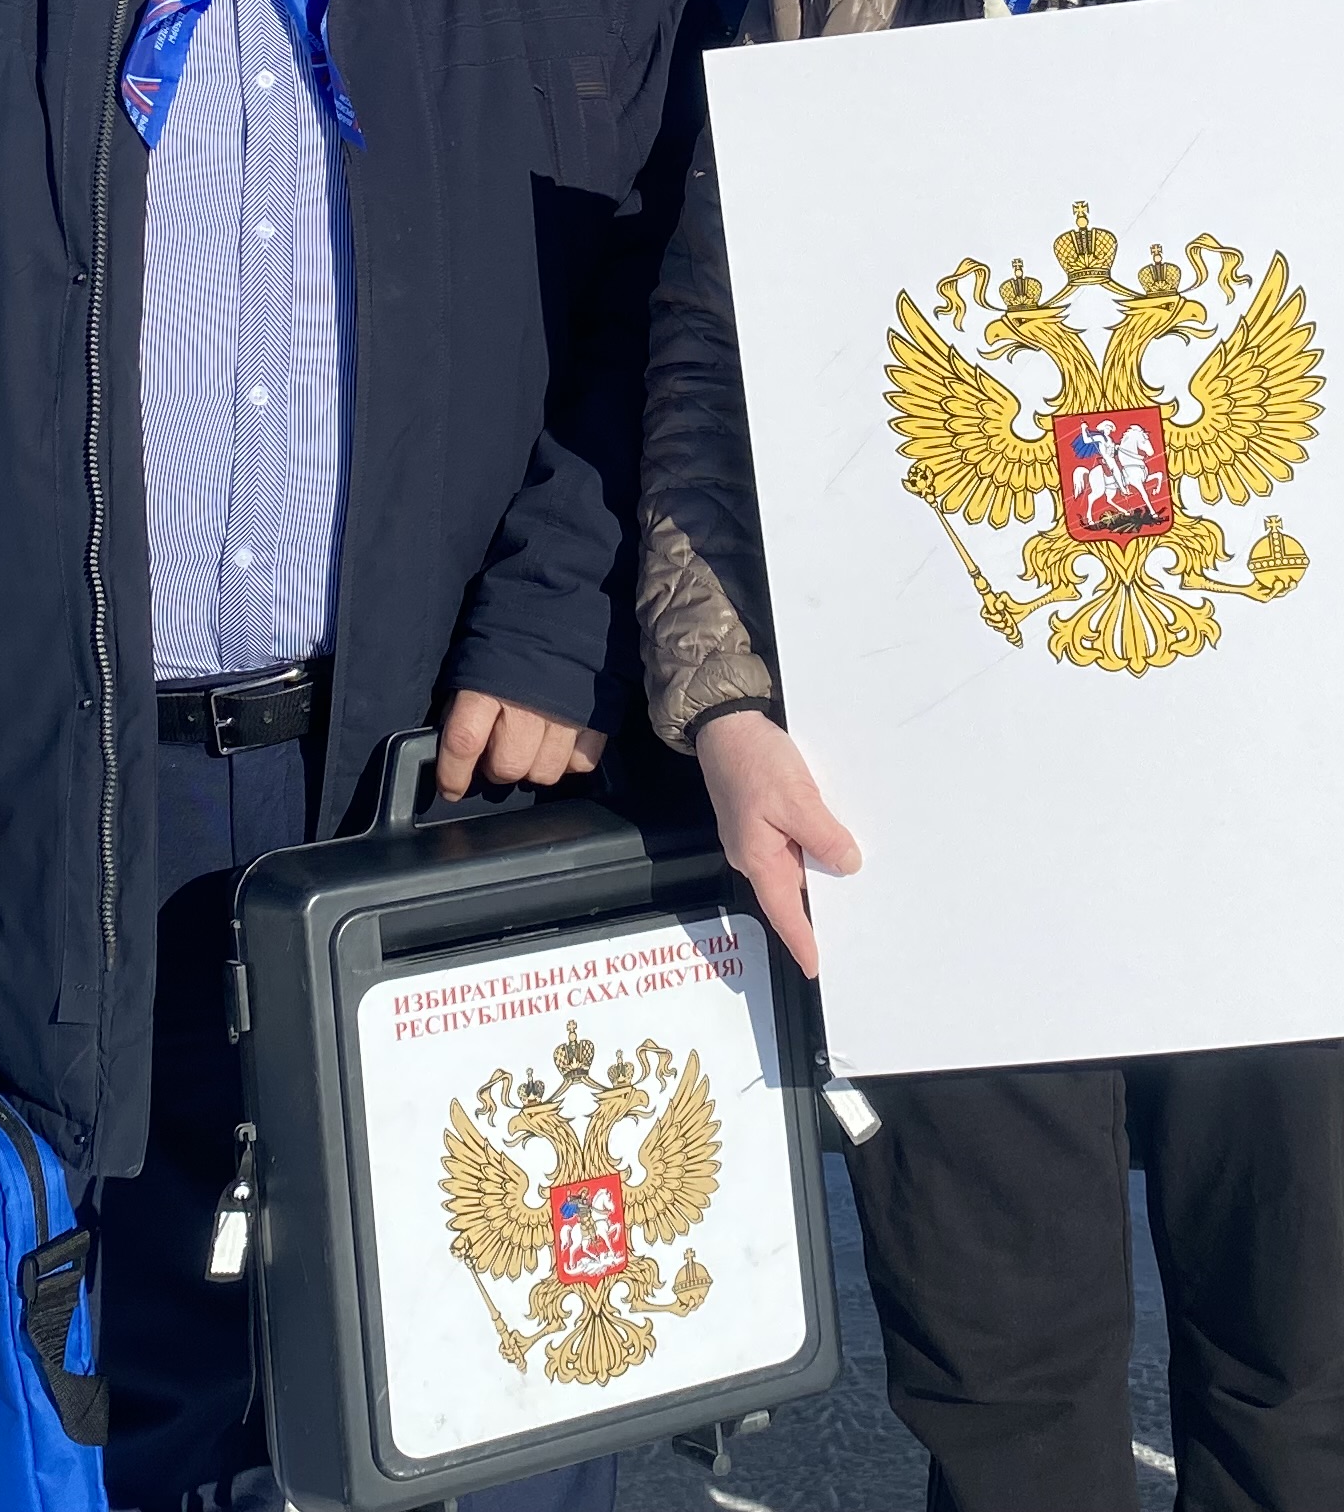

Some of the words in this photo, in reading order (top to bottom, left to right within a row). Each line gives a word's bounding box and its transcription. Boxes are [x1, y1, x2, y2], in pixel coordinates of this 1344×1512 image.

[394, 960, 597, 1016] ИЗБИРАТЕЛЬНАЯ
[605, 932, 740, 974] КОМИССИЯ
[395, 993, 560, 1042] РЕСПУБЛИКИ
[566, 980, 629, 1008] САХА
[635, 957, 744, 999] (ЯКУТИЯ)
